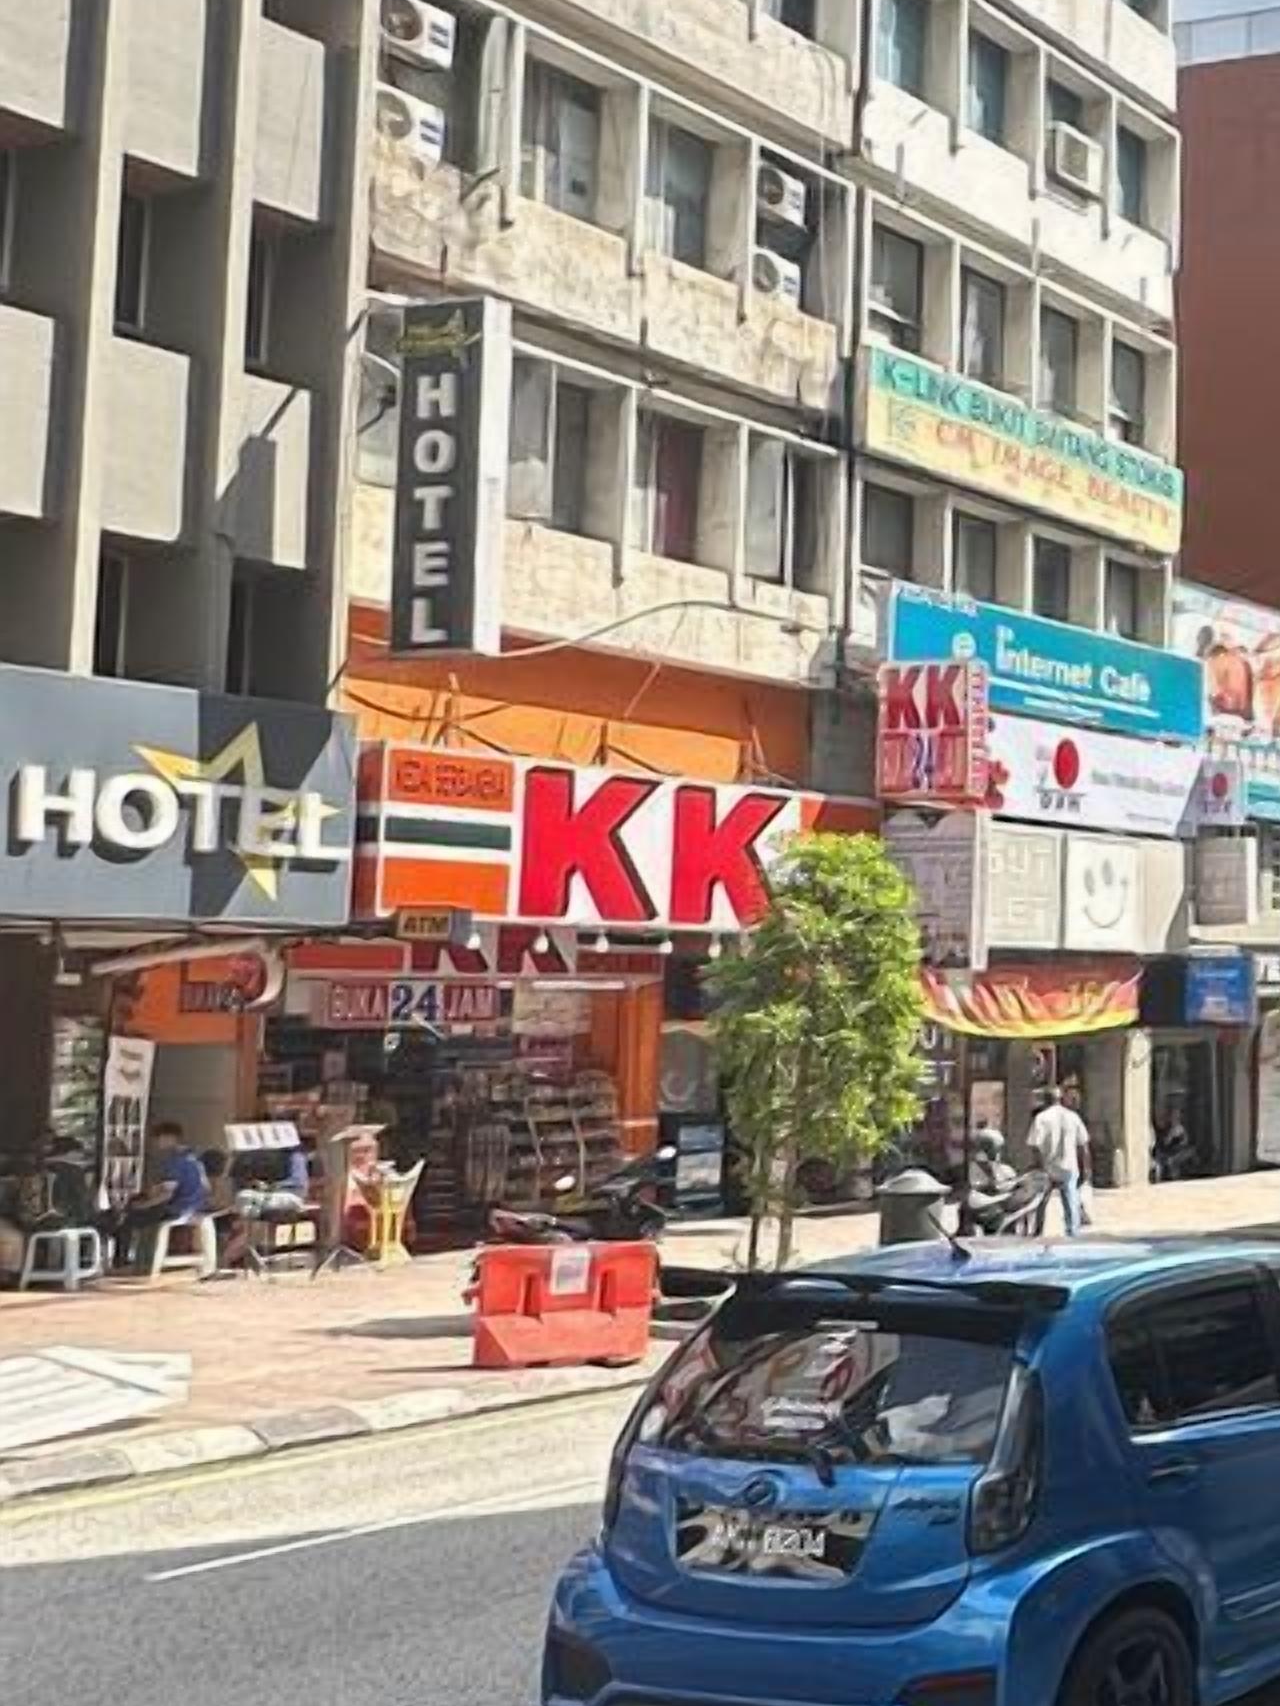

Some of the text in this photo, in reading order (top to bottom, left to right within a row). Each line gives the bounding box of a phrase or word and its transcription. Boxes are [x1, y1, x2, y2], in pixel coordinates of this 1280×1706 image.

[410, 373, 457, 644] HOTEL
[888, 662, 963, 730] KK
[996, 623, 1093, 690] Internet
[18, 764, 351, 859] HOTEL
[518, 766, 793, 928] KK
[391, 983, 439, 1021] 24
